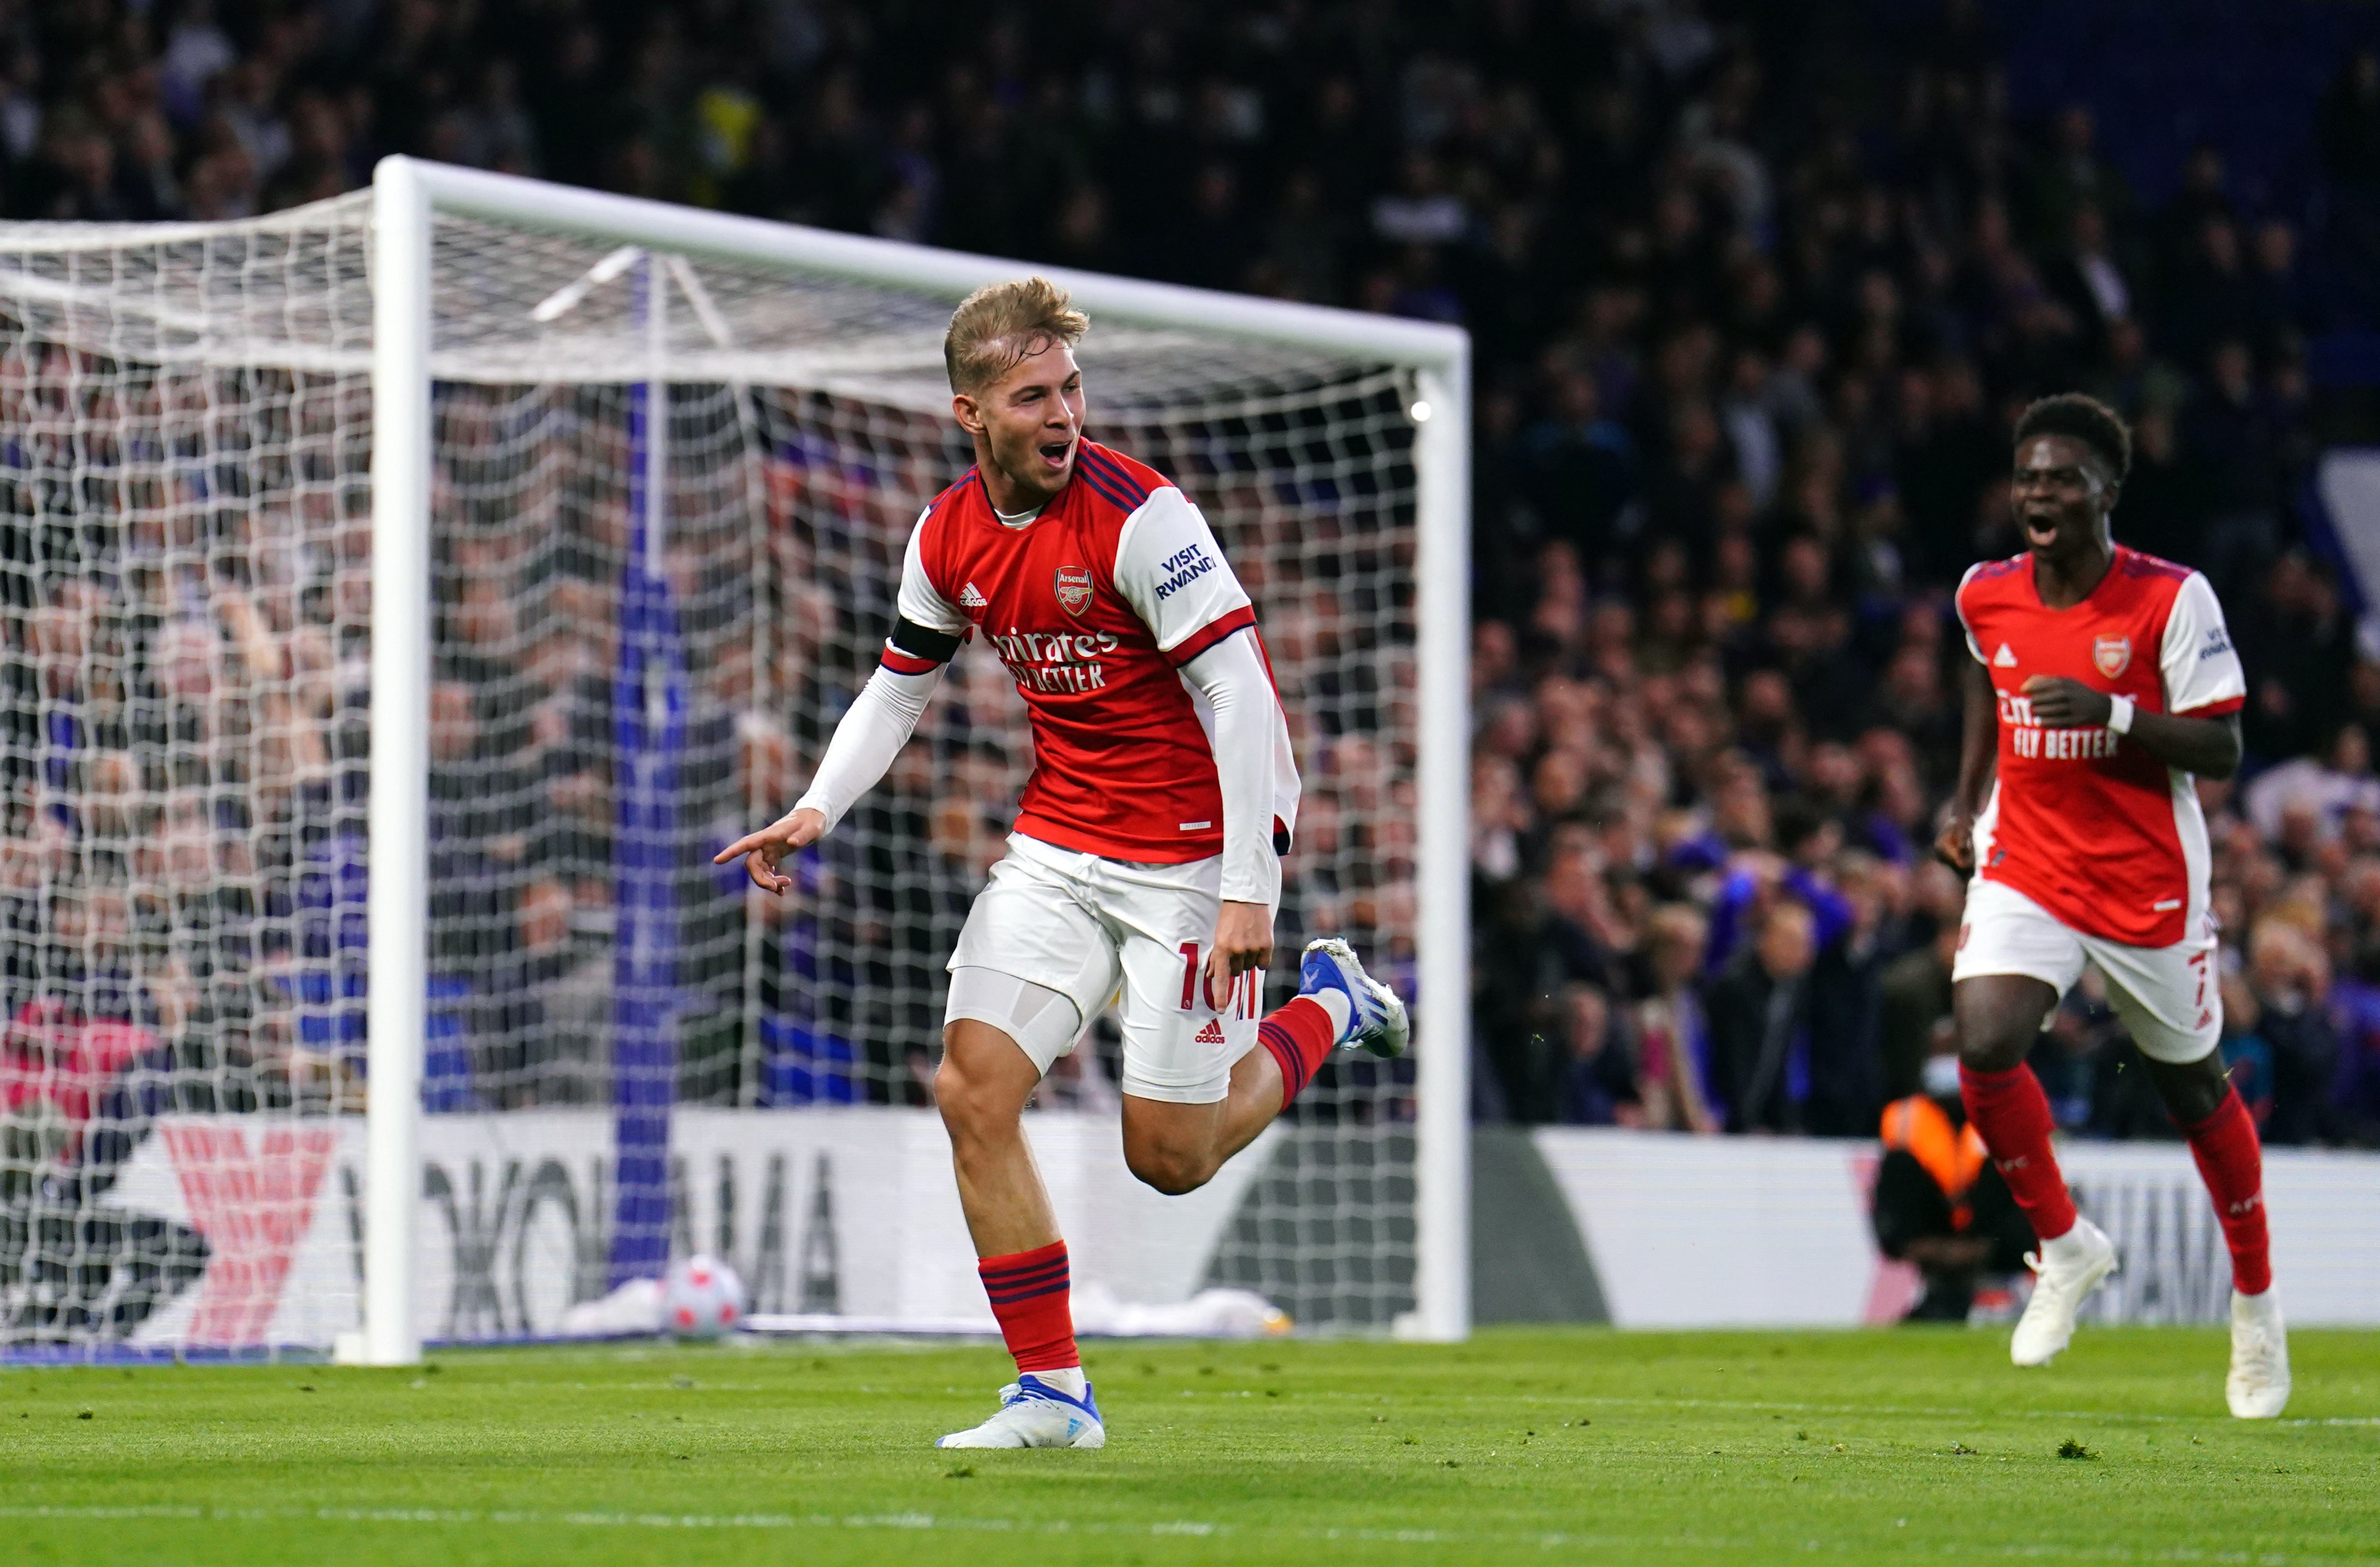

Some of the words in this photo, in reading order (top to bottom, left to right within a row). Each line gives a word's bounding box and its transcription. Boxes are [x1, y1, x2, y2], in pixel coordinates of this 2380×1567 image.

[1161, 544, 1201, 573] VISIT
[1059, 574, 1087, 584] Arsenal
[959, 597, 988, 606] adidas
[991, 626, 1118, 662] mirates
[1029, 660, 1106, 693] BETTER
[2013, 727, 2041, 759] FLY
[2045, 729, 2119, 760] BETTER
[1195, 1033, 1225, 1044] adidas
